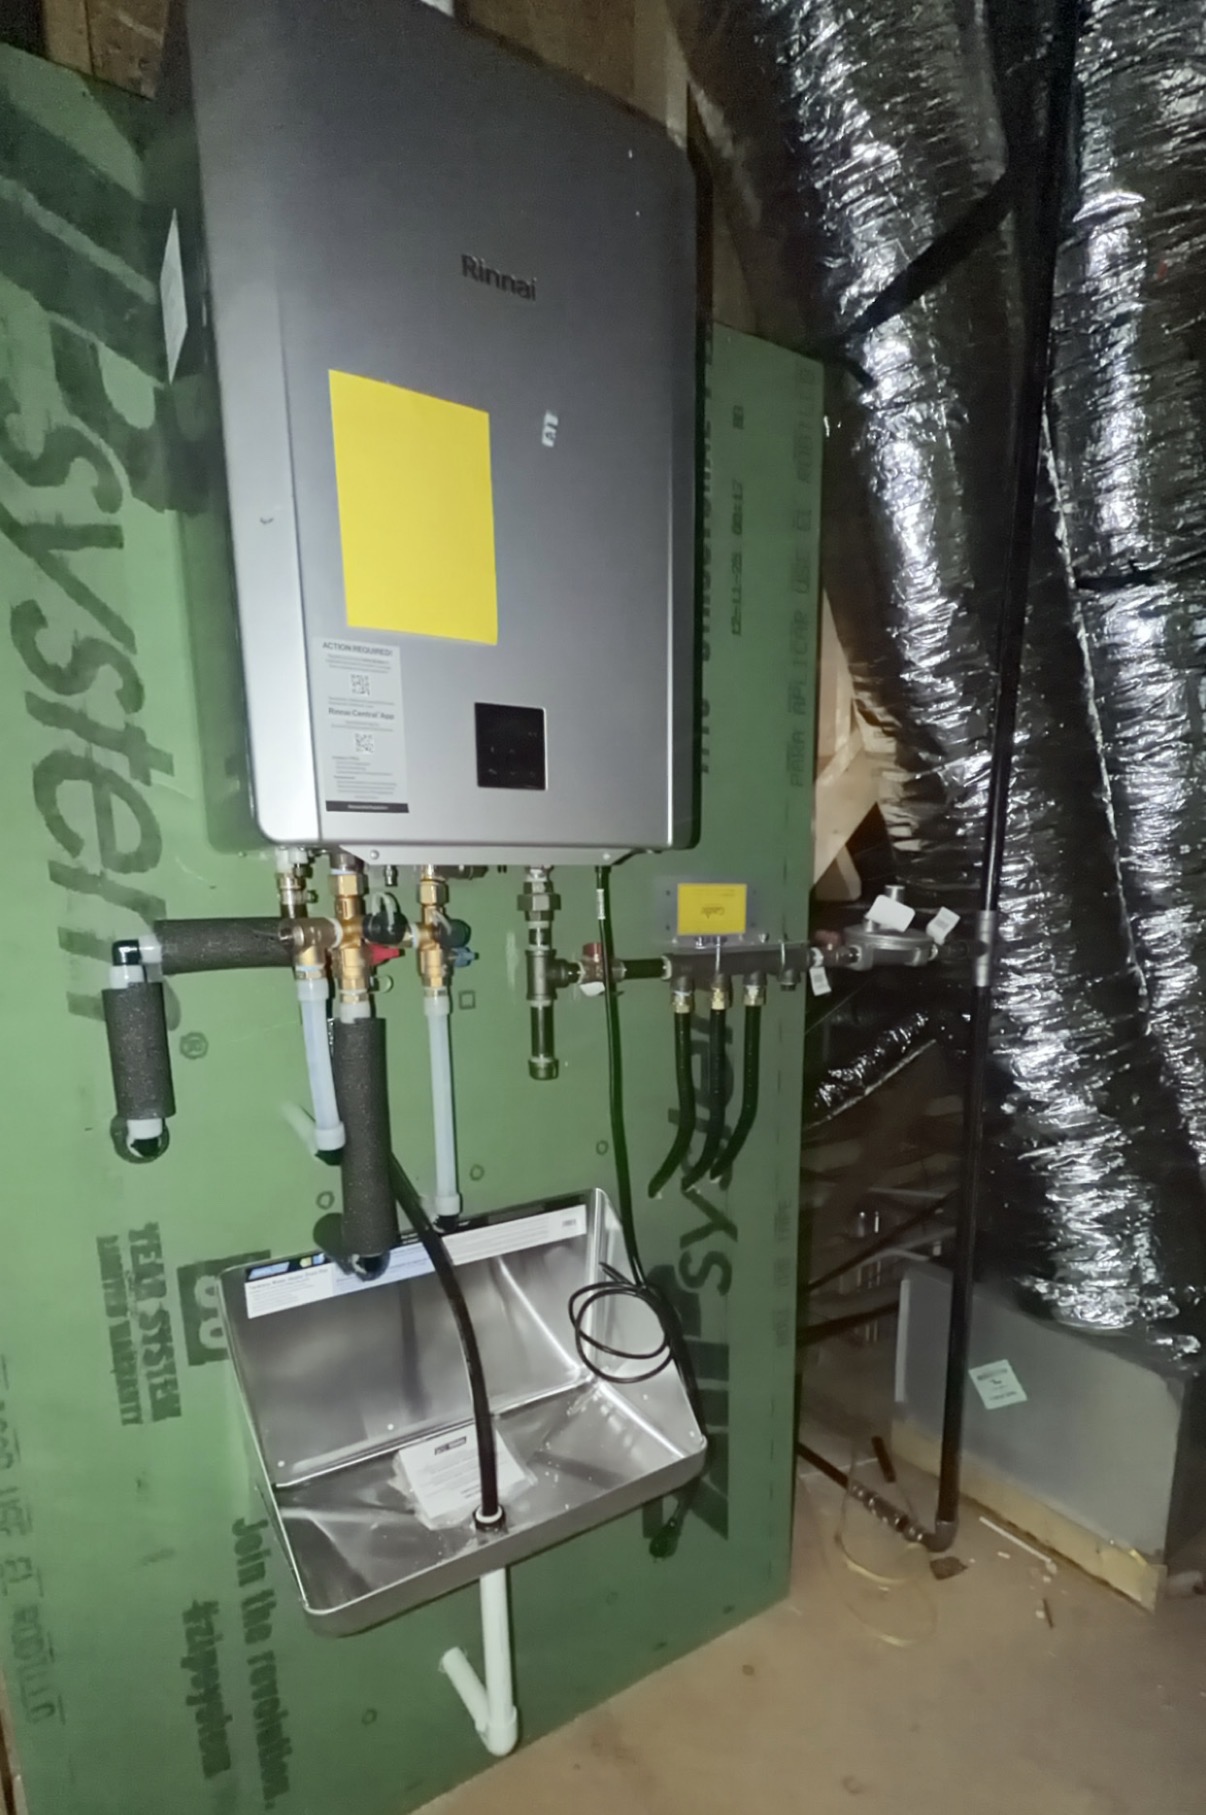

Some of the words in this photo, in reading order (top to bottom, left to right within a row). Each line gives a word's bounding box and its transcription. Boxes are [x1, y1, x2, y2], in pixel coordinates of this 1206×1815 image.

[460, 253, 537, 302] Rinnai
[322, 641, 352, 652] ACTION
[231, 1517, 269, 1588] Join
[241, 1588, 278, 1645] the
